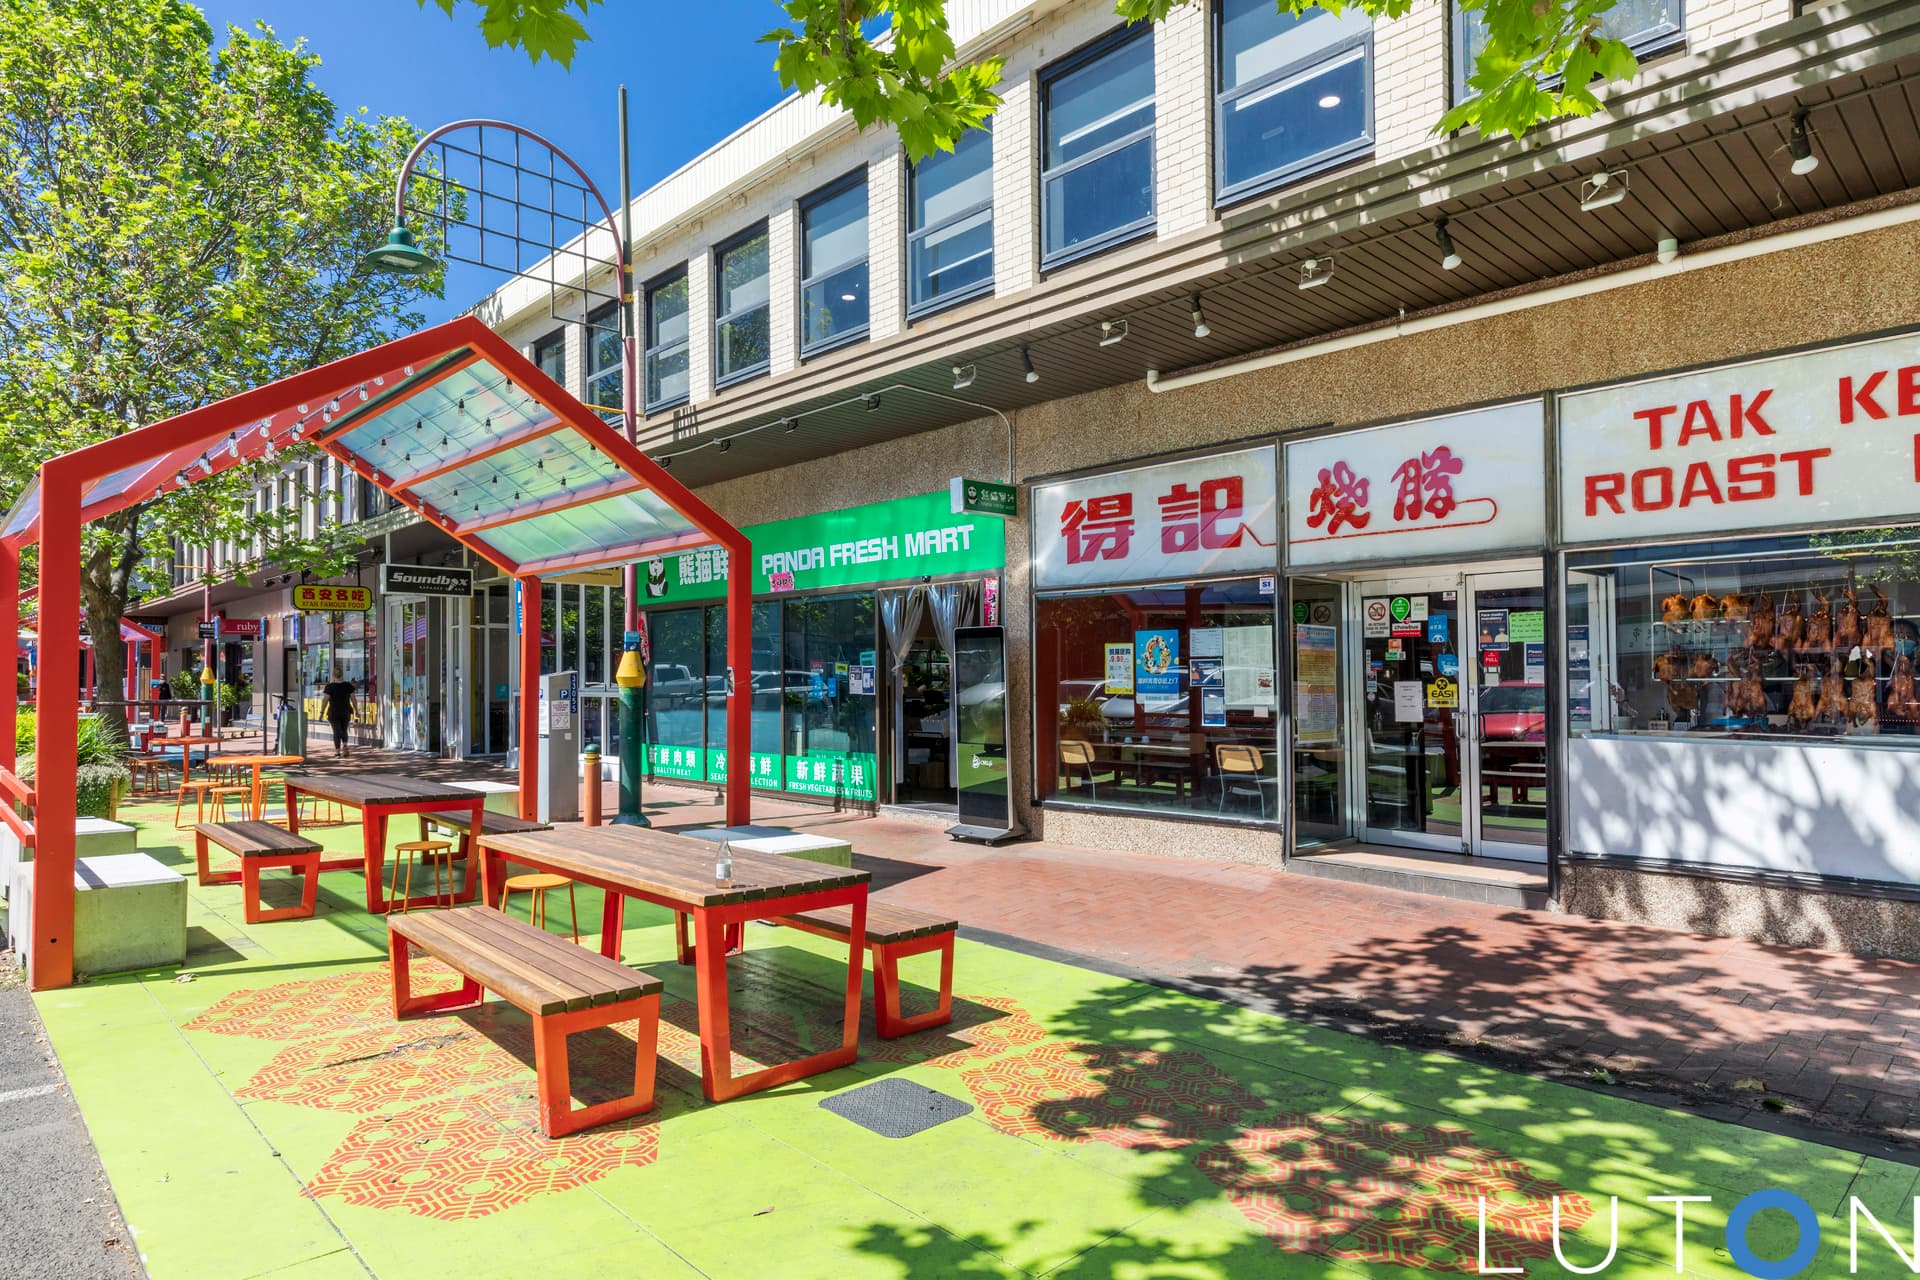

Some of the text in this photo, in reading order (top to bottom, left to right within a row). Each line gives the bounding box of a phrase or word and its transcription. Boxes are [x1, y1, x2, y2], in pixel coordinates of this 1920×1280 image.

[1633, 389, 1776, 450] TAK
[1585, 447, 1831, 516] ROAST
[1061, 475, 1243, 565] 得記
[761, 524, 974, 575] PANDA FRESH MART
[389, 572, 468, 587] Soundbox
[302, 588, 364, 601] 西安名吃
[237, 622, 259, 632] ruby
[561, 690, 568, 699] P
[1431, 690, 1454, 698] EASI
[676, 768, 692, 777] MEAT
[751, 777, 778, 788] LECTION
[789, 781, 807, 790] FRESH
[807, 784, 844, 795] VEGETABLES
